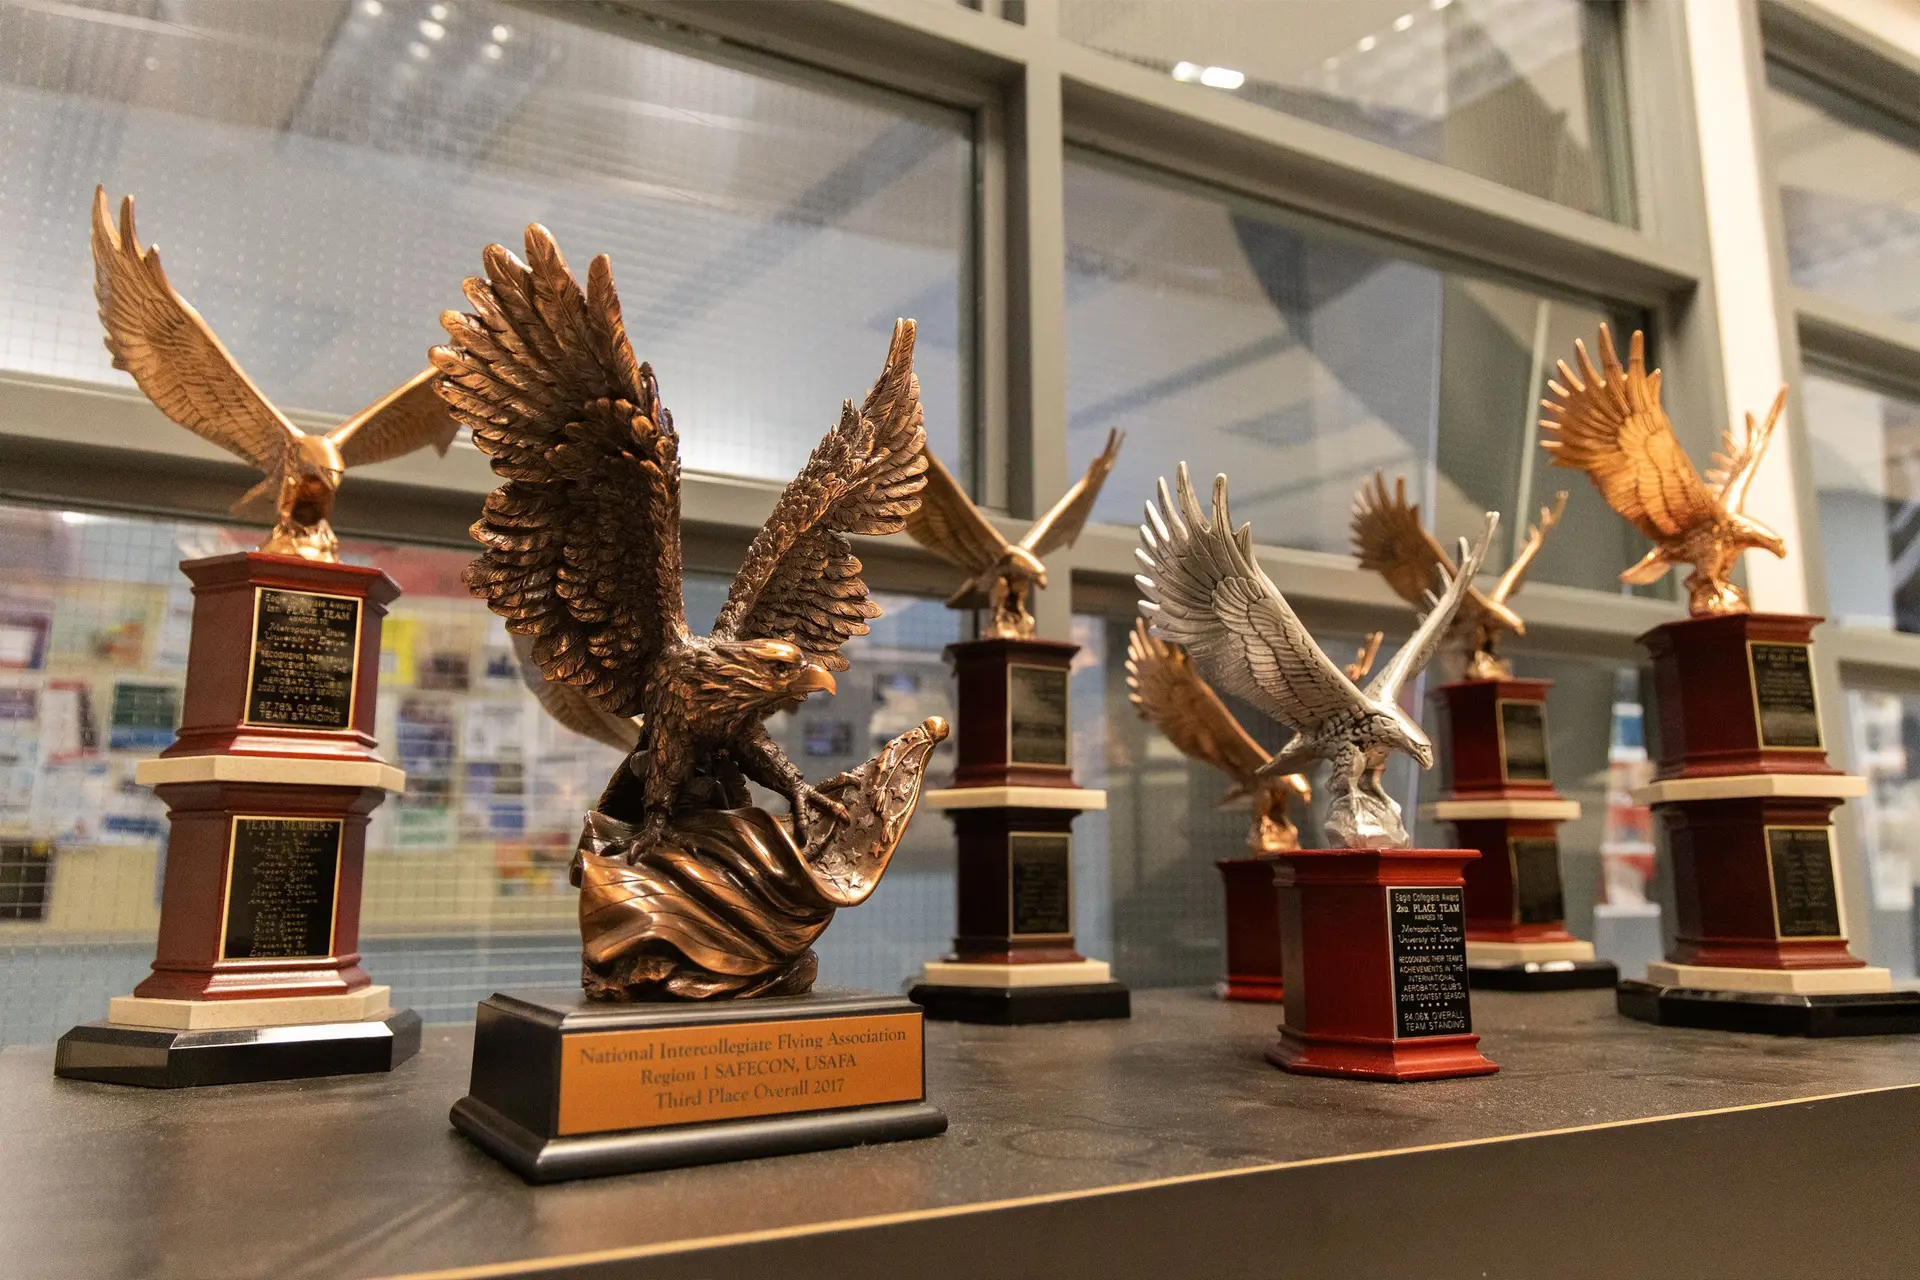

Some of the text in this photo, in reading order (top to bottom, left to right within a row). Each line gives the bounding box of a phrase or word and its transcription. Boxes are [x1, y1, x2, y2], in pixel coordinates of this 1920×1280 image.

[323, 609, 351, 620] TEAM
[263, 676, 310, 686] AEROBATIC
[278, 686, 314, 694] CONTEST
[297, 704, 340, 715] OVERALL
[259, 710, 340, 723] TEAM STANDING
[246, 820, 275, 830] TEAM
[1395, 893, 1411, 903] Eagle
[1413, 904, 1436, 912] PLACE
[1439, 903, 1460, 912] TEAM
[1401, 924, 1459, 933] Metropolitan State
[1397, 934, 1462, 944] University of Denver
[1399, 965, 1443, 973] ACHIEVEMENTS
[1408, 974, 1456, 982] INTERNATIONAL
[1403, 983, 1439, 992] AEROBATIC
[1416, 992, 1442, 1000] CONTEST
[1432, 1011, 1464, 1020] OVERALL
[1406, 1020, 1465, 1031] TEAM STANDING
[579, 1028, 906, 1066] National Intercollegiate Flying Association
[641, 1067, 696, 1088] Region
[805, 1053, 857, 1072] USAFA
[654, 1078, 844, 1111] Third Place Overall 2017
